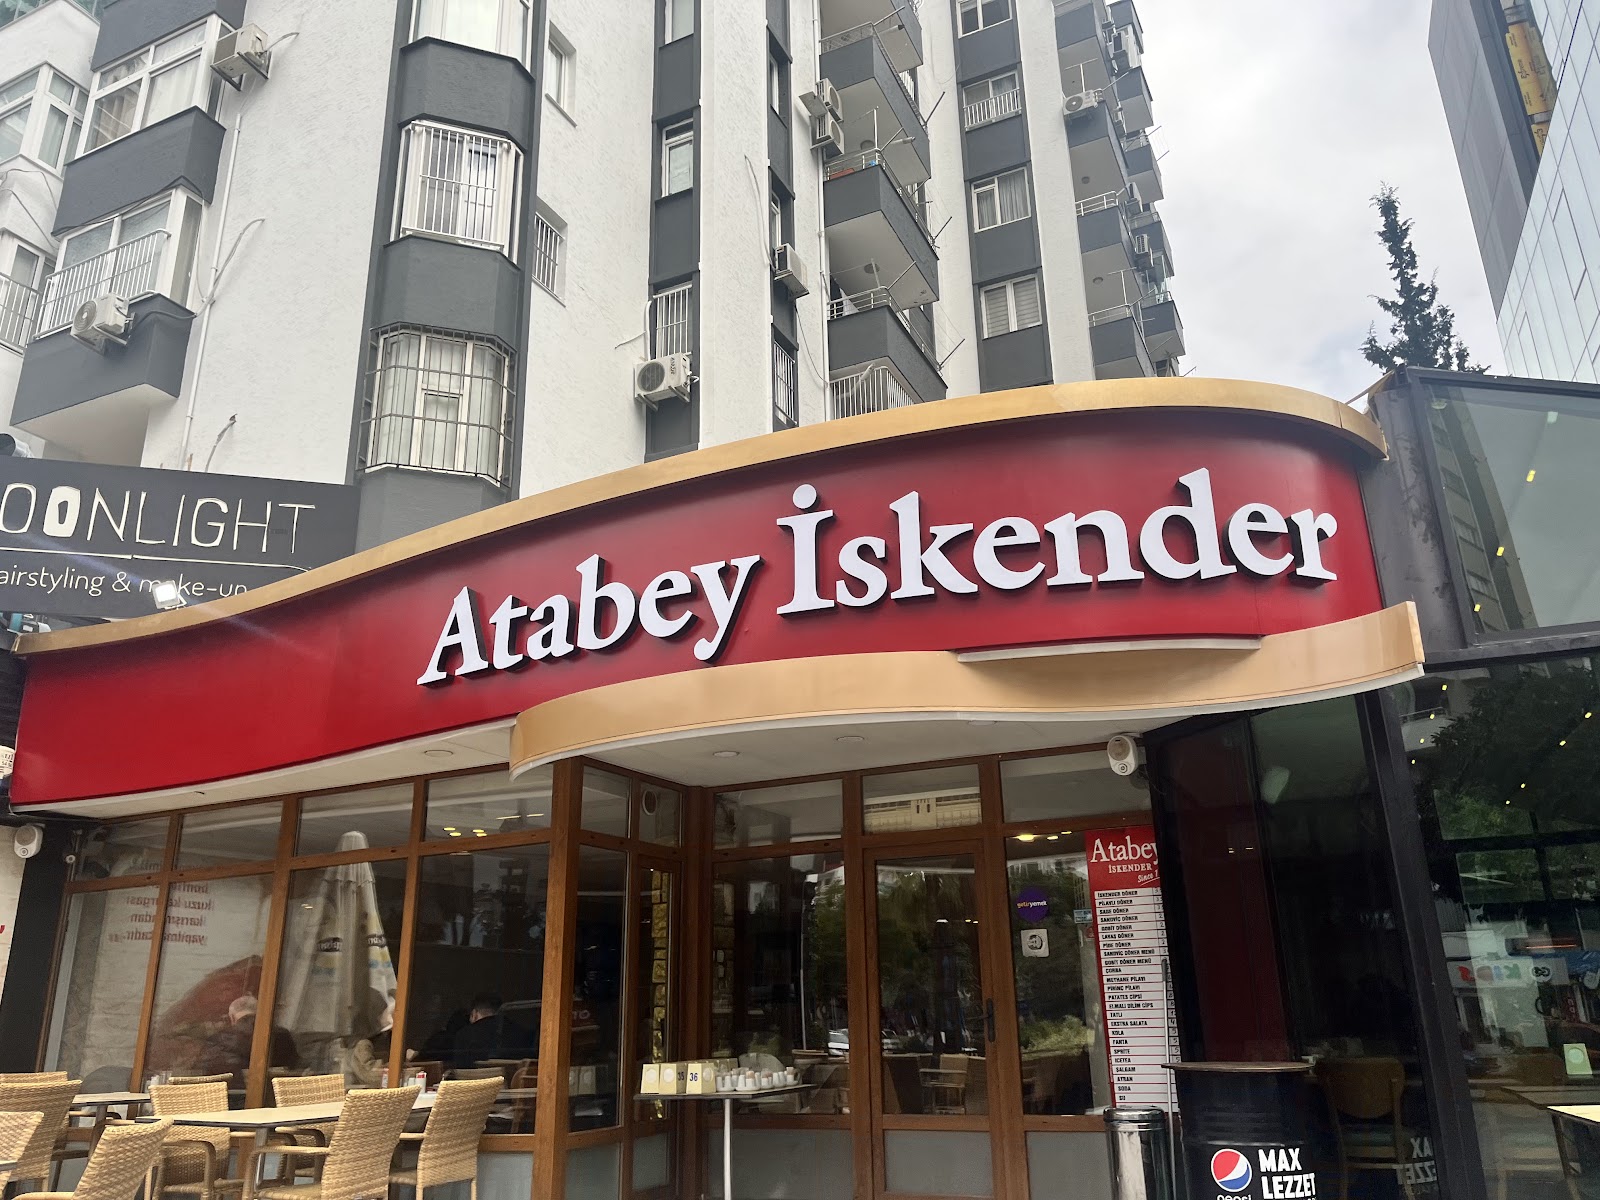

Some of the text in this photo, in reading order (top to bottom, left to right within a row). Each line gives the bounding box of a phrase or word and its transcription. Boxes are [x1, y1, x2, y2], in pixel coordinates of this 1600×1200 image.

[111, 571, 132, 593] &
[416, 467, 1337, 686] Atabey İskender
[1108, 863, 1152, 873] İSKENDER
[689, 1072, 699, 1082] 36
[1258, 1148, 1302, 1172] MAX
[1261, 1172, 1316, 1199] LEZZET
